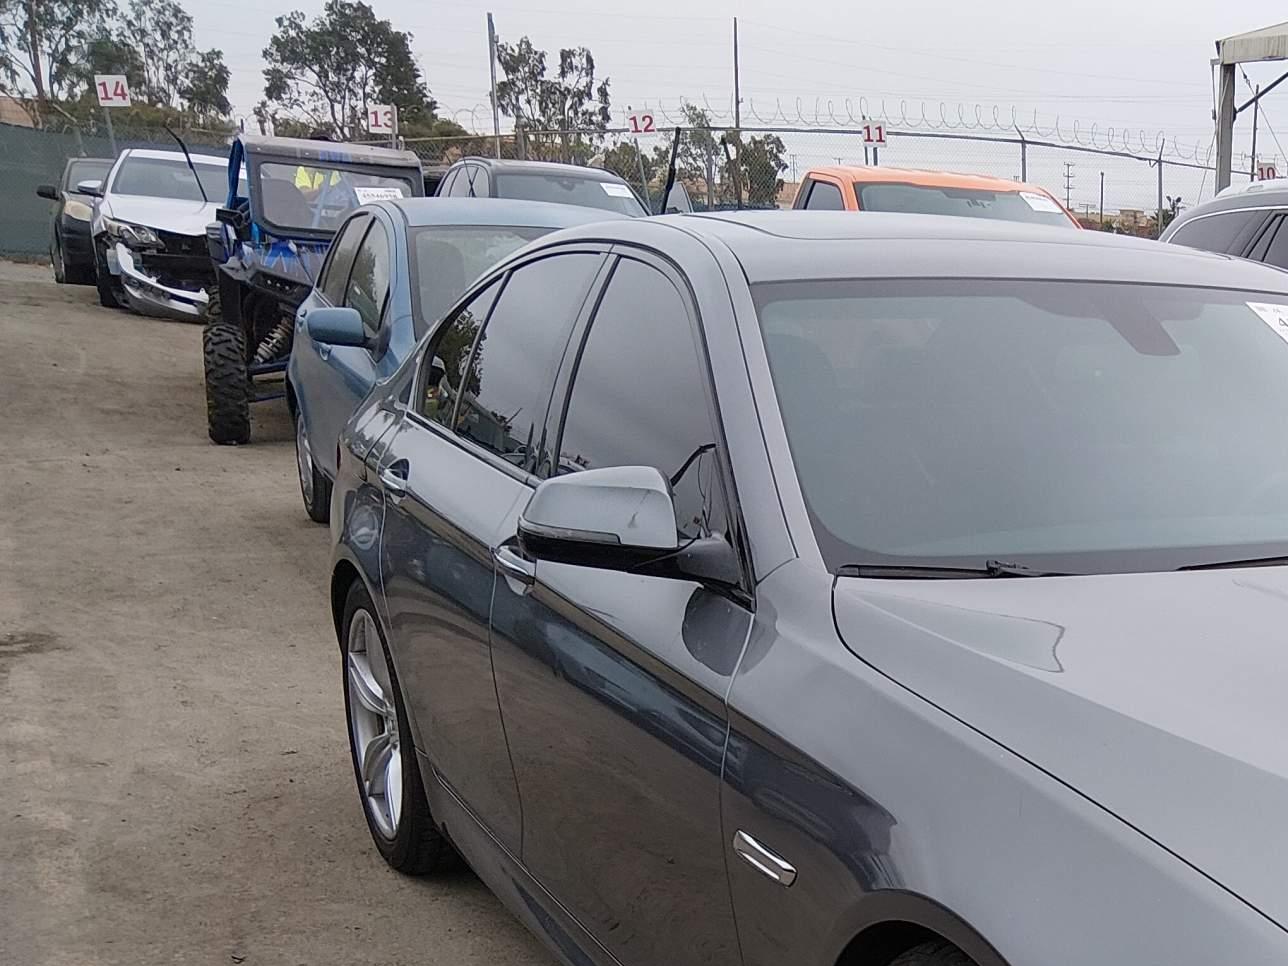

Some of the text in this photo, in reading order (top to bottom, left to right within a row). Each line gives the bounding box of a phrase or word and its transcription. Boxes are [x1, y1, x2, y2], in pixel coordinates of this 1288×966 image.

[98, 81, 128, 101] 14
[370, 110, 394, 128] 13
[629, 115, 656, 133] 12
[863, 125, 886, 143] 11
[1258, 167, 1276, 181] 10
